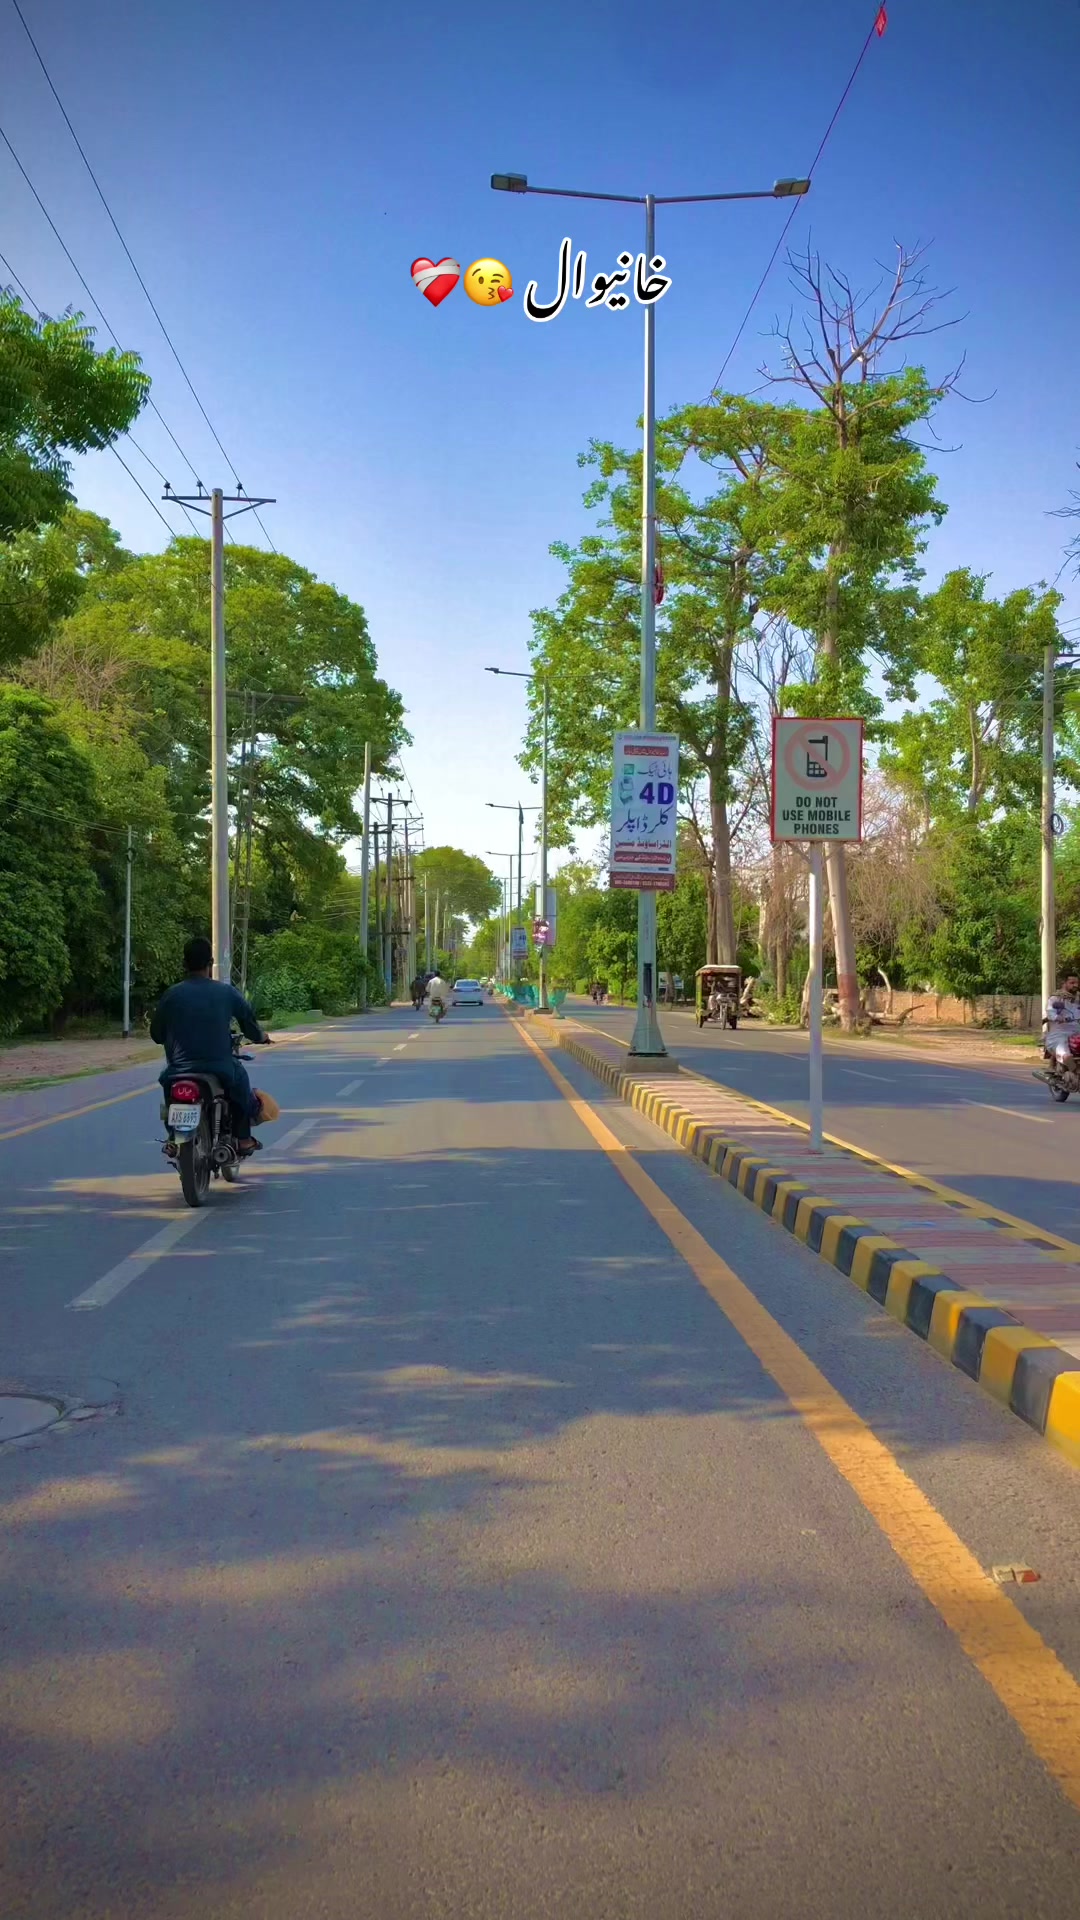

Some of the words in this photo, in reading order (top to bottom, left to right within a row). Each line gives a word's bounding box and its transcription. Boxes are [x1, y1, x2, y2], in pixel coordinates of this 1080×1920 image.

[639, 782, 674, 805] 4D
[796, 797, 811, 808] DO
[816, 797, 838, 808] NOT
[782, 810, 804, 821] USE
[808, 810, 851, 821] MOBILE
[794, 823, 839, 834] PHONES
